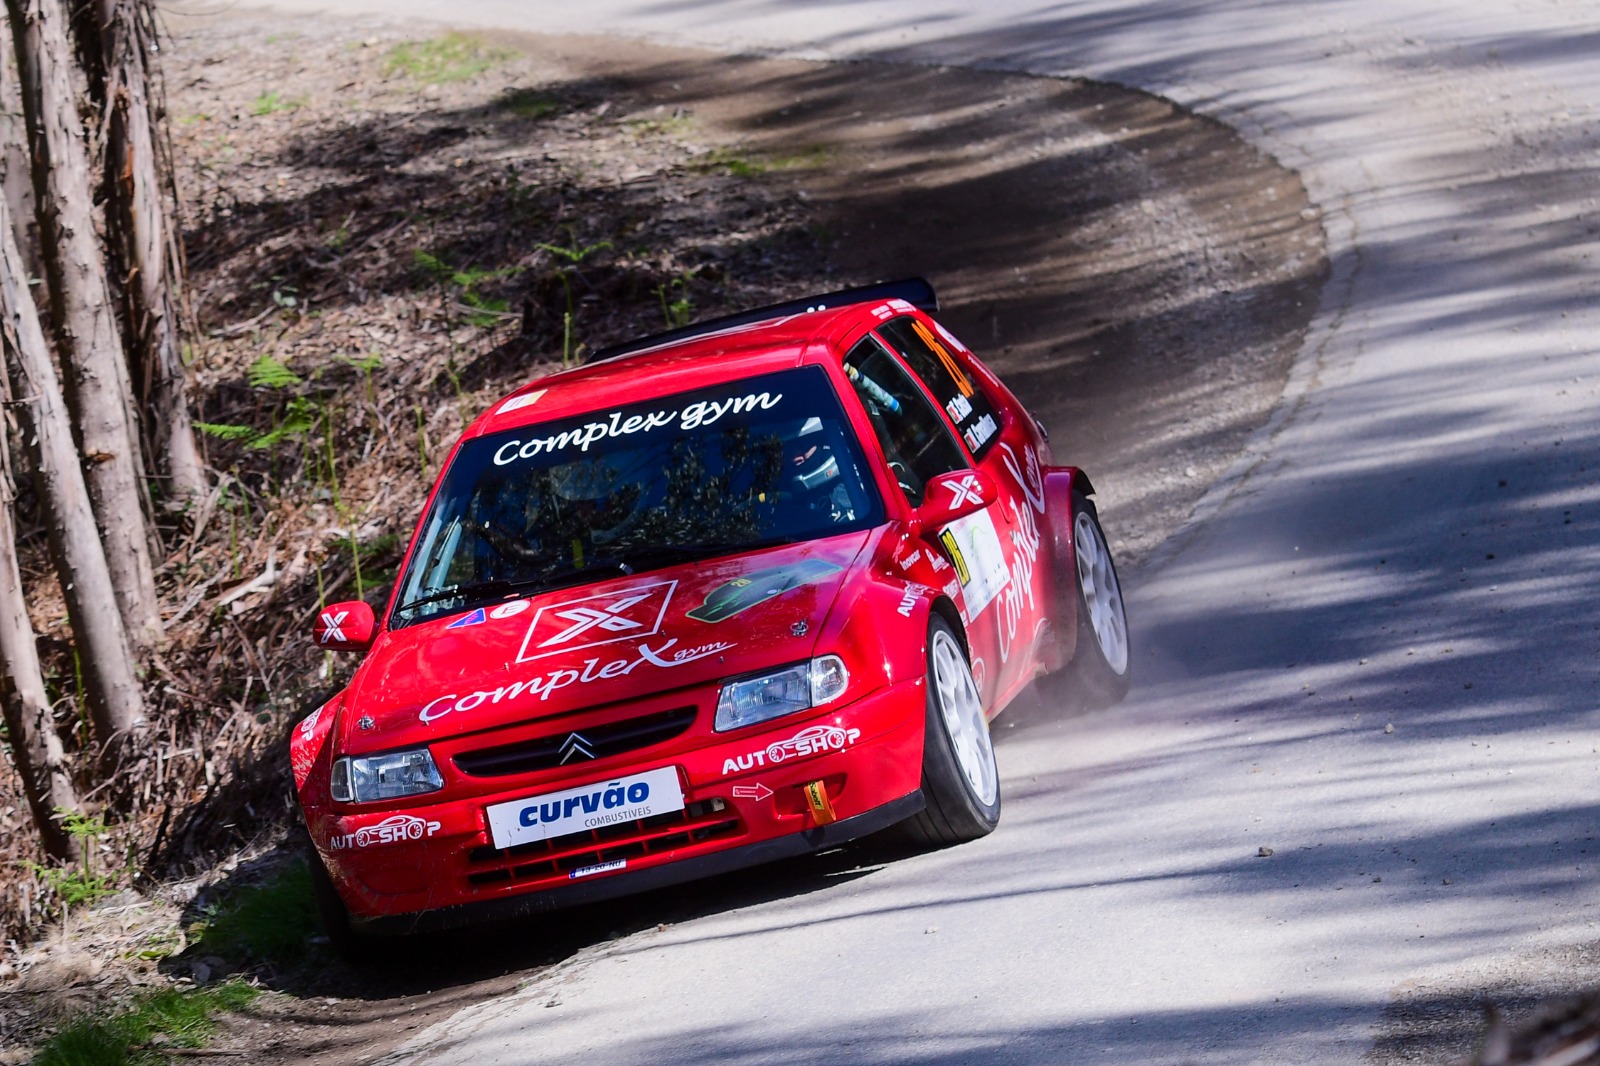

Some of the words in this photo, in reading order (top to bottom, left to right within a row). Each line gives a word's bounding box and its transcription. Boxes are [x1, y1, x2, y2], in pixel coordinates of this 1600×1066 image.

[493, 410, 677, 466] Complex
[680, 391, 783, 430] gym
[673, 641, 731, 662] gym
[518, 781, 650, 827] curvão
[584, 806, 652, 828] COMBUSTÍVEIS
